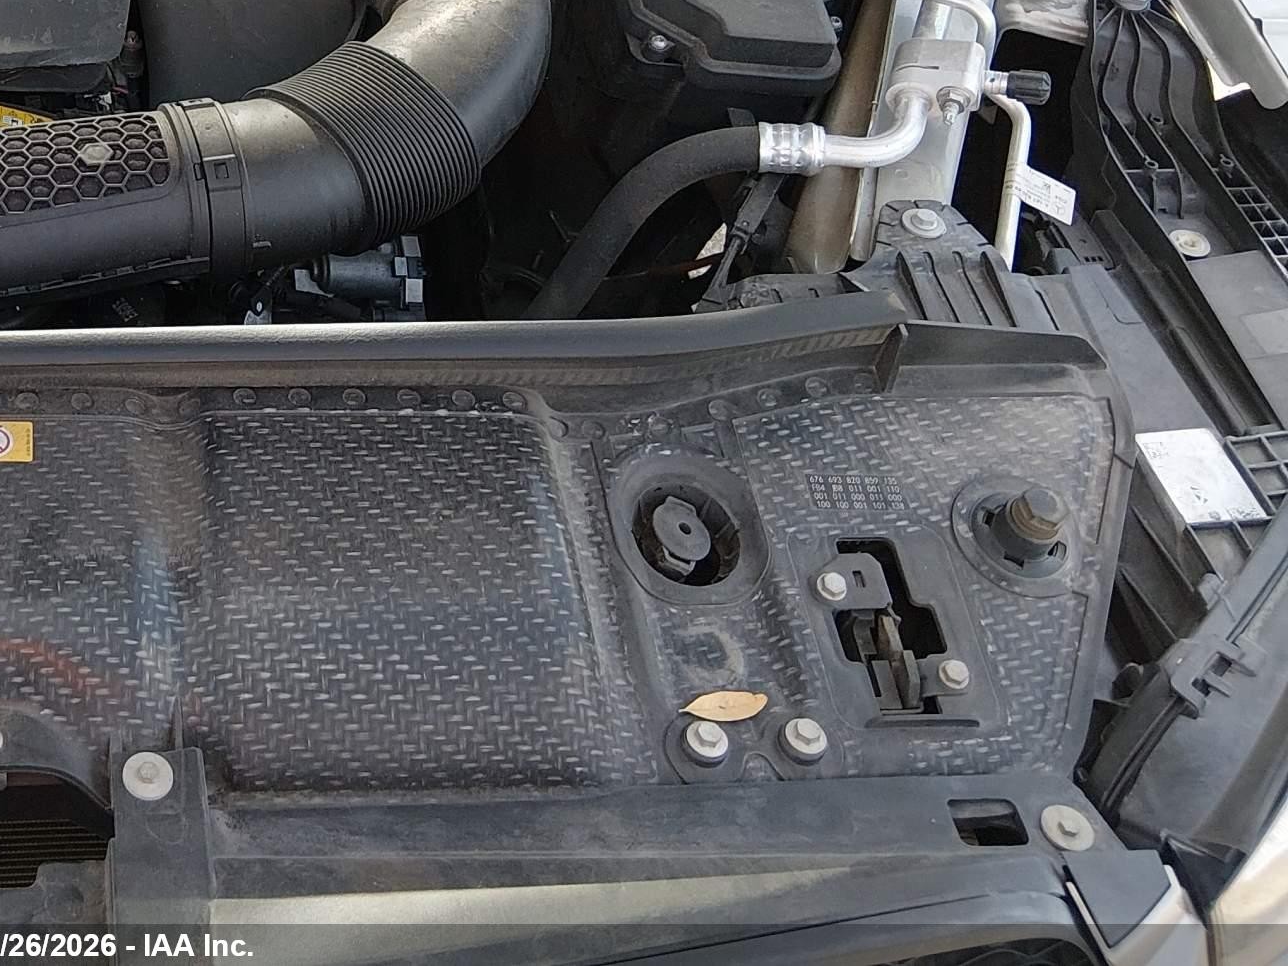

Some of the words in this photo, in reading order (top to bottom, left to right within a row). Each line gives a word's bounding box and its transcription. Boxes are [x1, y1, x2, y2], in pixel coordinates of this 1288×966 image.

[809, 475, 824, 483] 676
[828, 475, 843, 484] 693
[846, 476, 861, 484] 820
[883, 476, 897, 485] 135
[848, 484, 863, 492] 011
[866, 485, 881, 493] 001
[886, 485, 900, 493] 110
[813, 492, 828, 500] 001
[832, 492, 846, 500] 011
[851, 493, 866, 501] 000
[887, 494, 903, 502] 000
[816, 500, 831, 508] 100
[835, 501, 849, 509] 100
[853, 501, 868, 509] 001
